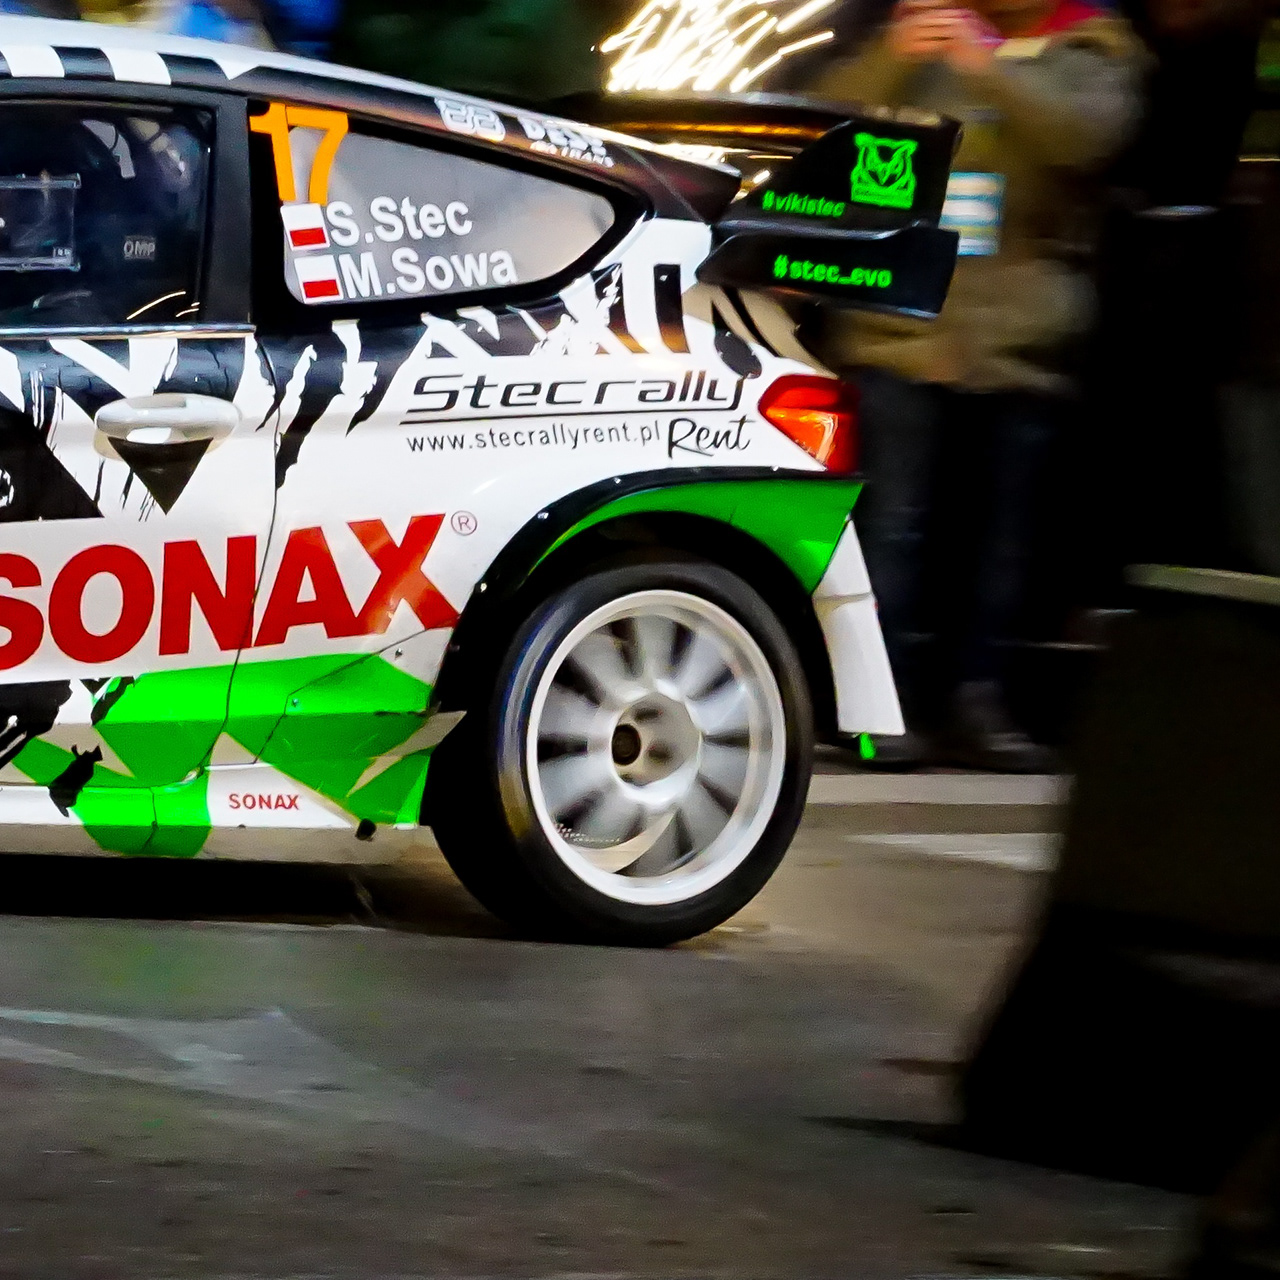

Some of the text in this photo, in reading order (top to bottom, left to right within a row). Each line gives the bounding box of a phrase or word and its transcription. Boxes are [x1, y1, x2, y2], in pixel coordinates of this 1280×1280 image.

[250, 102, 349, 205] 17
[327, 195, 473, 247] S.Stec
[338, 246, 519, 299] M.Sowa
[773, 254, 892, 288] #stec_evo
[406, 370, 745, 415] Stecrally
[406, 416, 758, 459] www.stecrallyrent.pl Rent
[228, 793, 300, 812] SONAX
